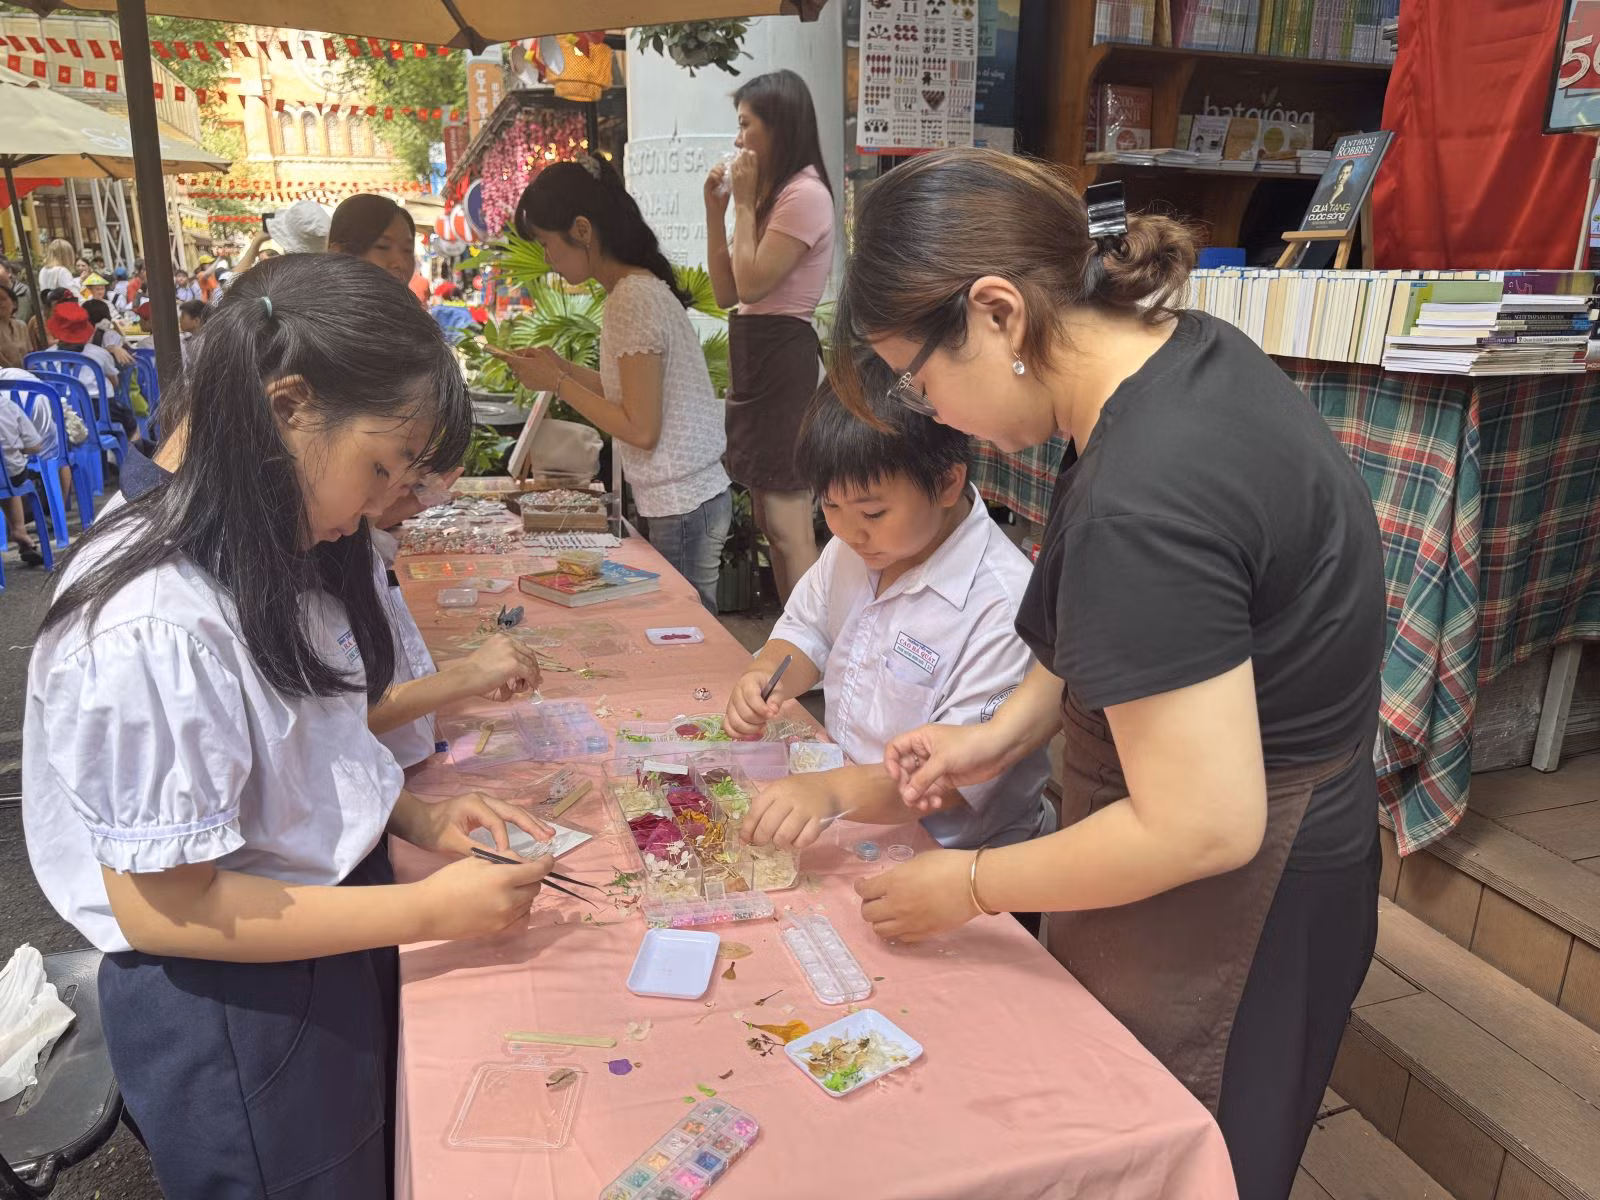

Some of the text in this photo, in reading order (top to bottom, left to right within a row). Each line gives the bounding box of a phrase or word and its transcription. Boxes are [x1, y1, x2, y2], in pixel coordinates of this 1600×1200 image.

[1341, 137, 1378, 148] ANTHONY
[1336, 145, 1374, 157] ROBBINS
[899, 638, 912, 649] CAO
